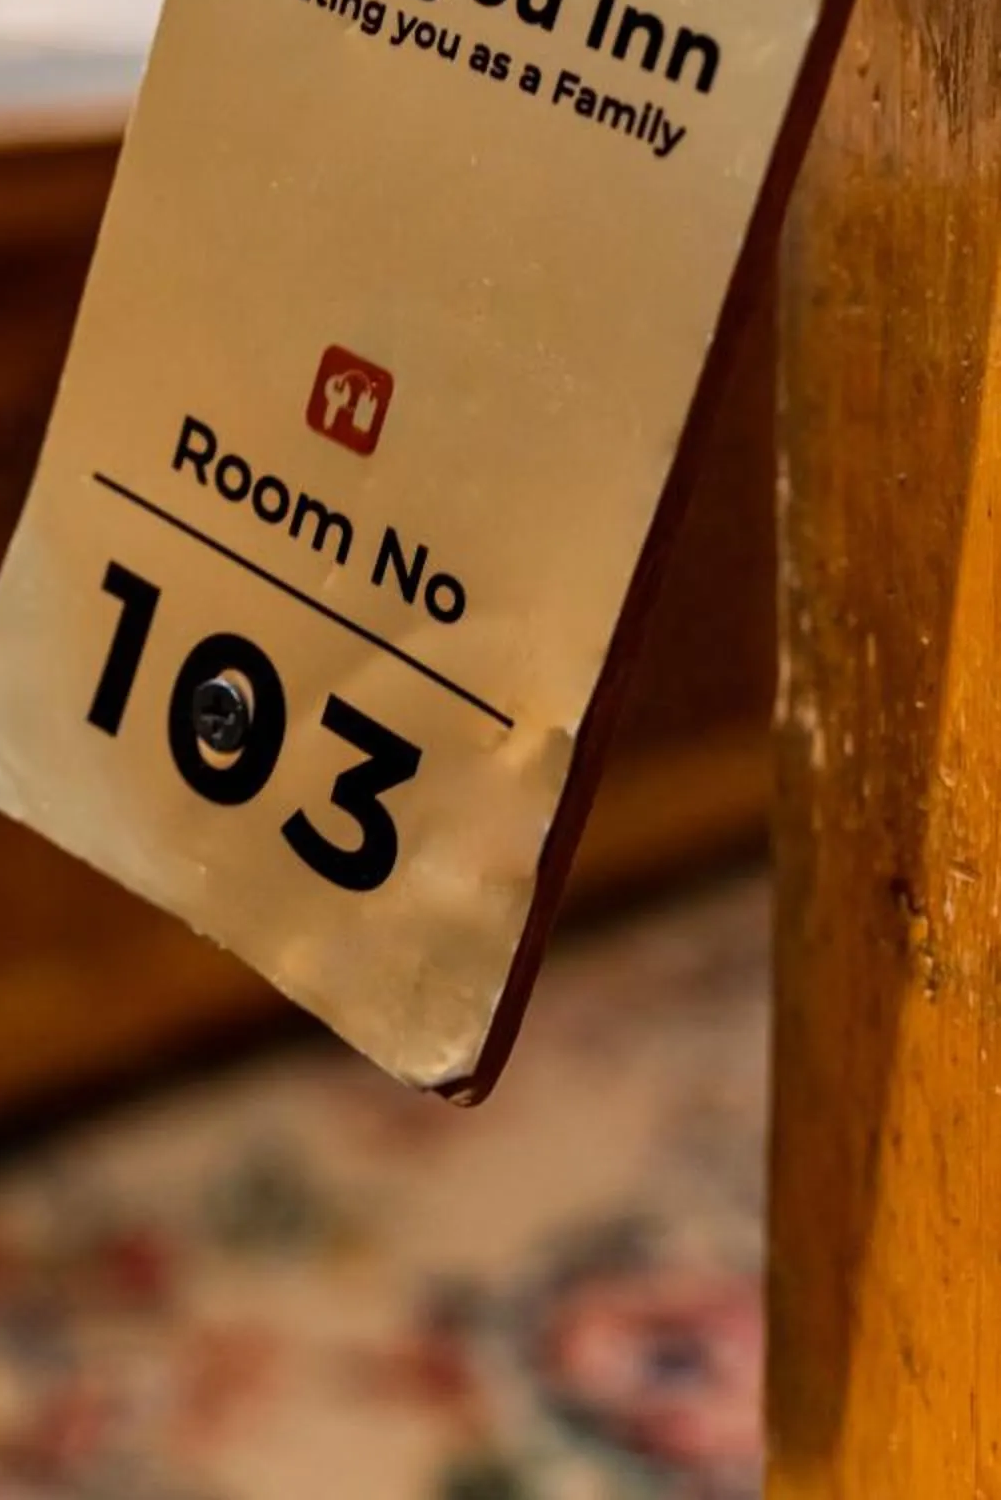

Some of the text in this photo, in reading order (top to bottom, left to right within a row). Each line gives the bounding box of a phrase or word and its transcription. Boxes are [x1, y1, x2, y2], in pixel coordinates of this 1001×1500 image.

[389, 10, 462, 61] you
[468, 43, 512, 82] as
[518, 63, 542, 96] a
[551, 69, 687, 159] Family
[171, 414, 468, 626] Room No
[86, 559, 424, 893] 103
